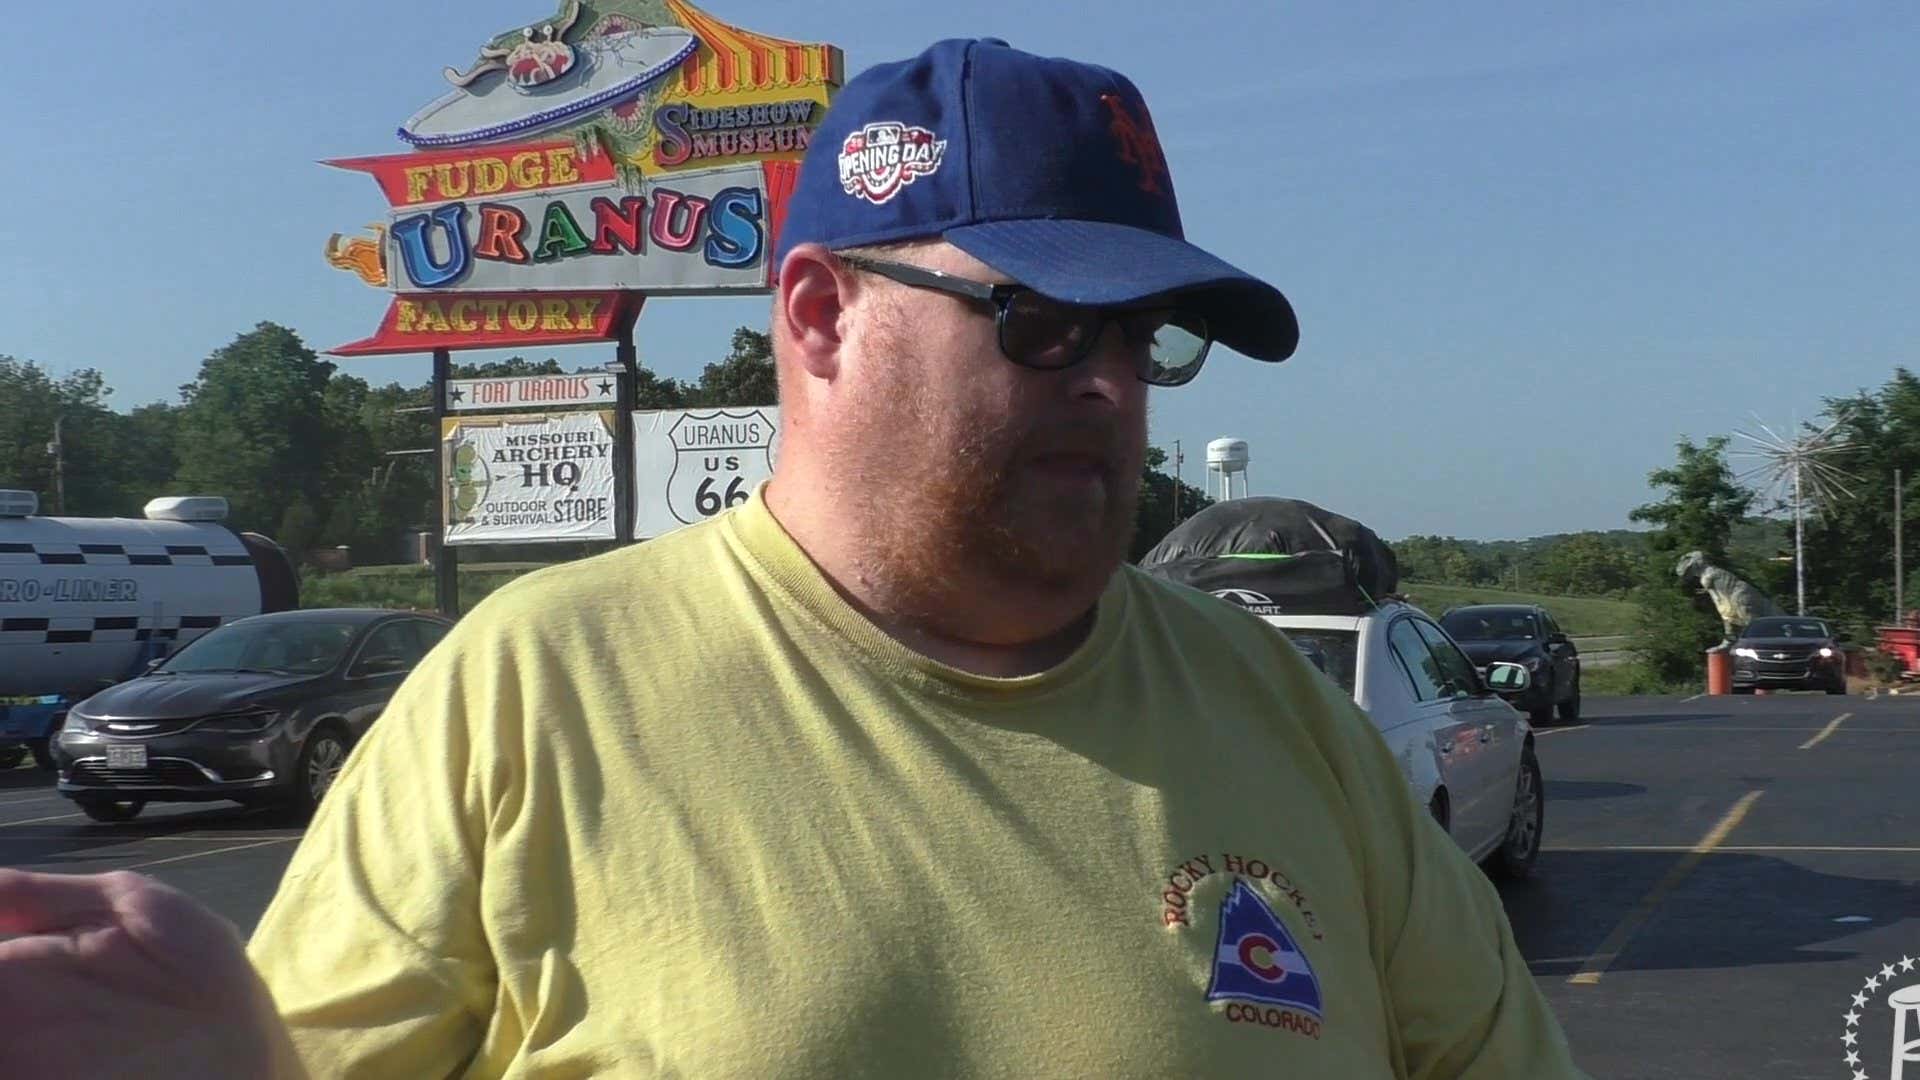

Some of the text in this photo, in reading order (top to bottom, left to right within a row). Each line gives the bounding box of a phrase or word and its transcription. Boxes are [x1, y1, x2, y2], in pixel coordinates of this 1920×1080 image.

[654, 100, 815, 166] SIDESHOW
[407, 148, 578, 202] FUDGE
[839, 144, 900, 180] OPENING
[902, 139, 947, 163] DAY
[391, 187, 764, 289] URANUS
[395, 299, 602, 333] FACTORY
[471, 376, 590, 404] FORT URANUS
[506, 431, 595, 447] MISSOURI
[684, 423, 760, 446] URANUS
[492, 444, 608, 463] ARCHERY
[704, 456, 740, 472] US
[521, 461, 581, 492] HQ
[486, 500, 547, 513] OUTDOOR
[553, 497, 608, 523] STORE
[695, 476, 750, 517] 66
[481, 511, 552, 526] & SURVIVAL
[1163, 854, 1216, 927] ROCKY
[1238, 934, 1286, 982] C
[1226, 1003, 1321, 1040] COLORADO
